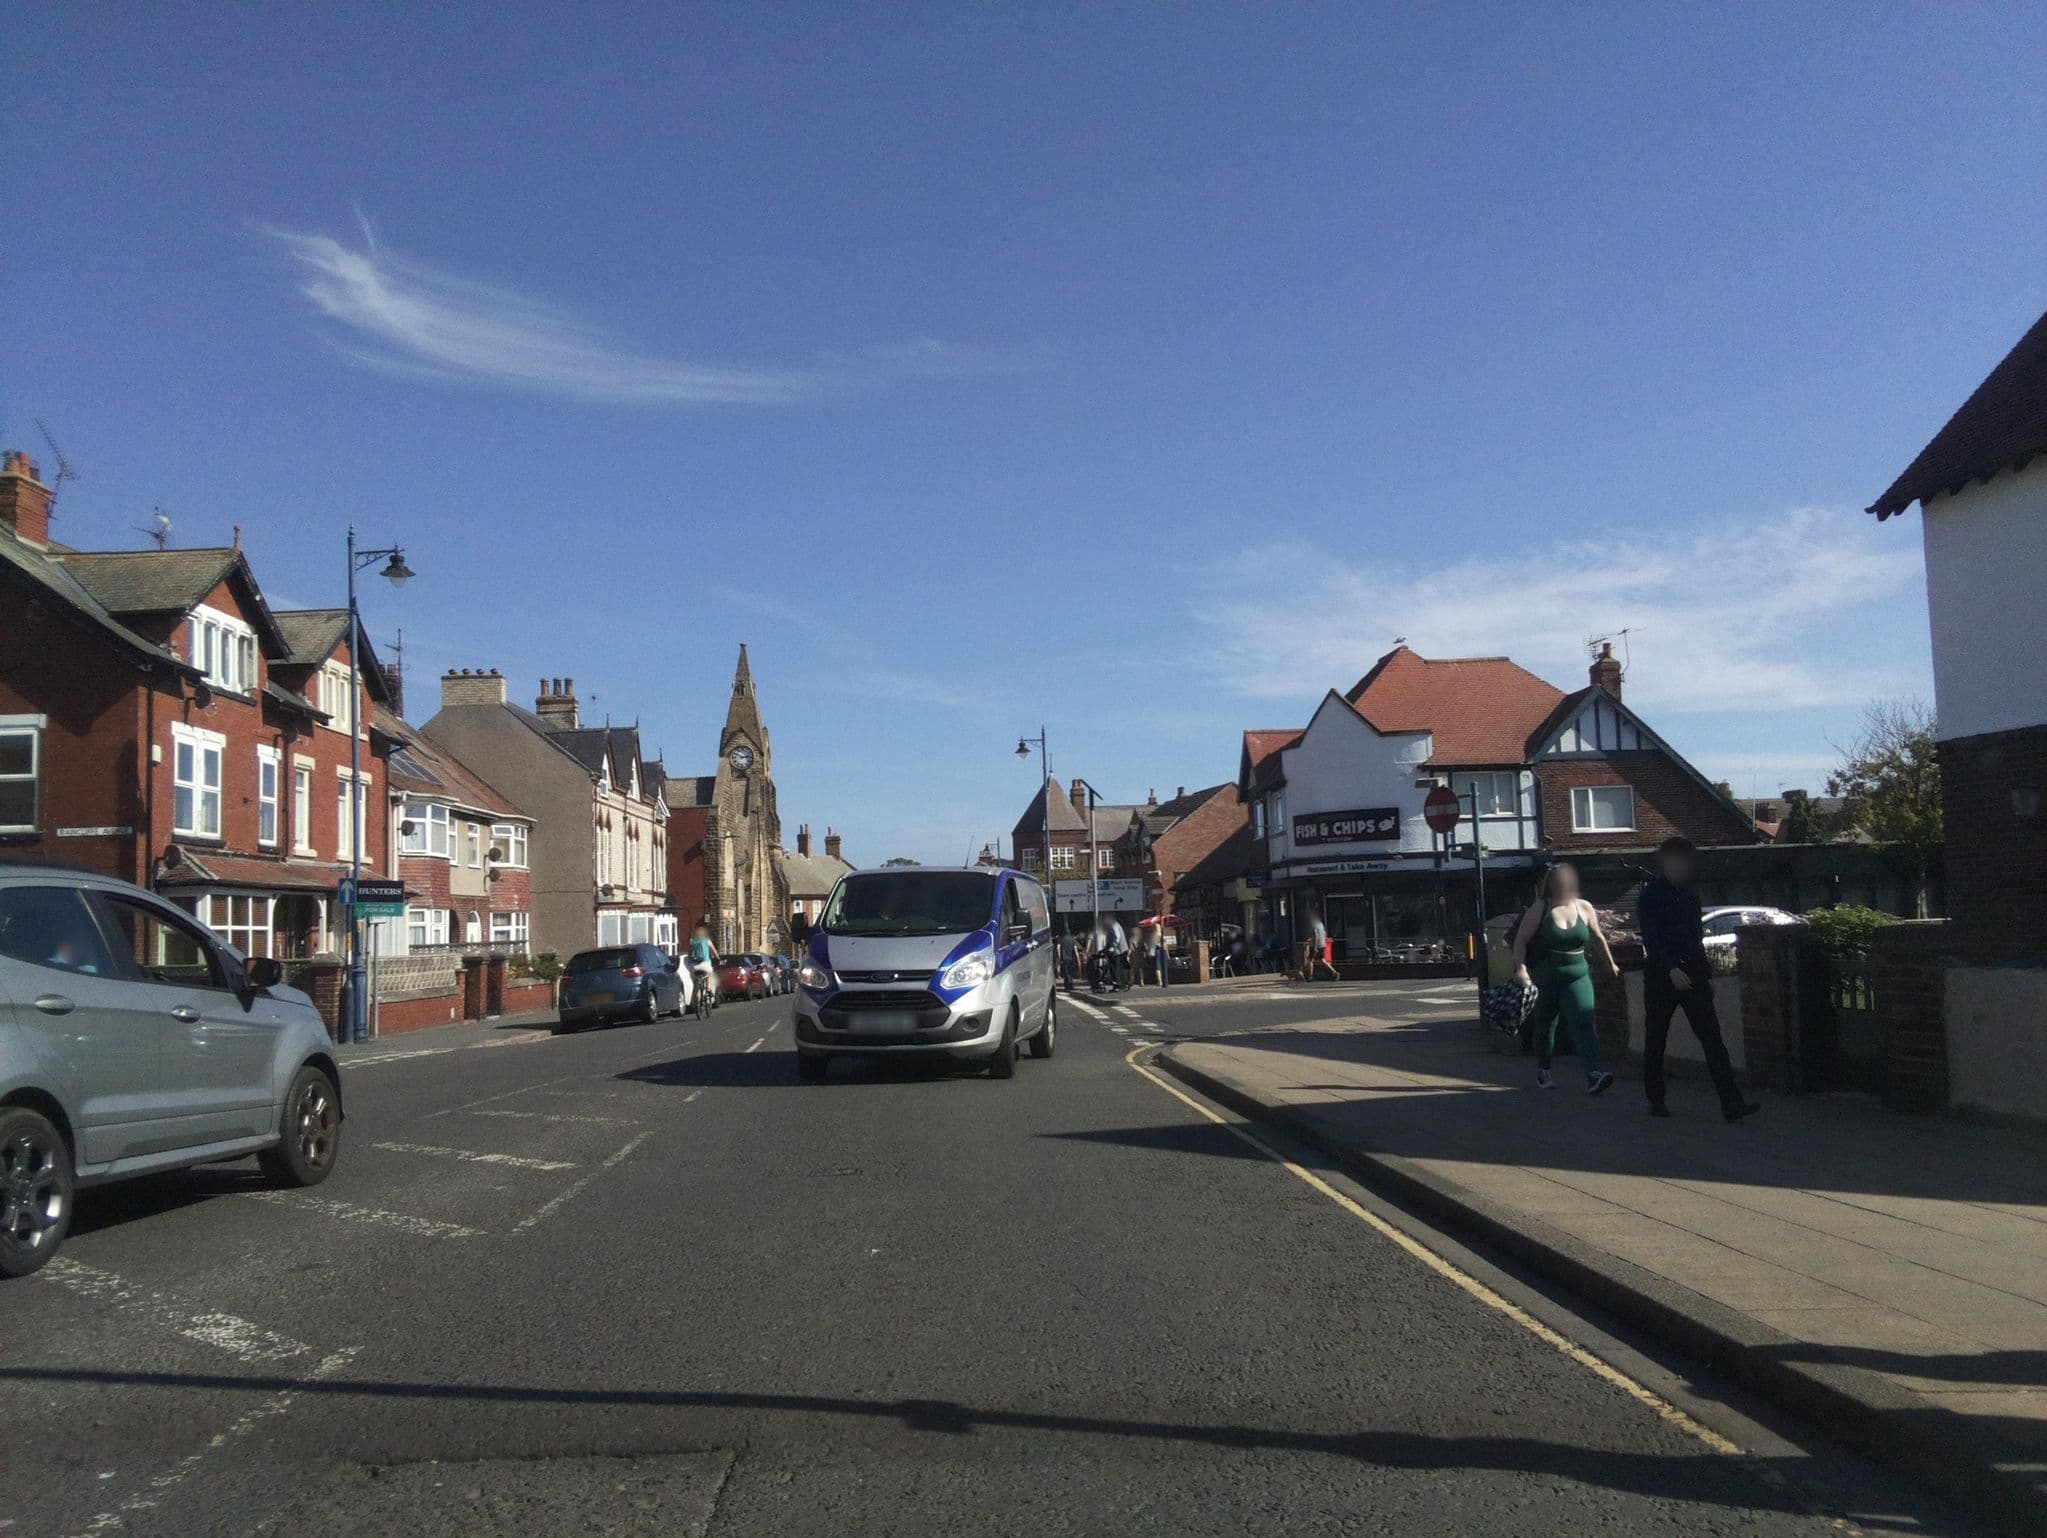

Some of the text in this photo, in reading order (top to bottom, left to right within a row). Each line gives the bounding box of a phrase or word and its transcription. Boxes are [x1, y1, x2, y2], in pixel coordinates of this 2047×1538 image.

[1295, 819, 1376, 839] FISH & CHIPS
[1347, 863, 1365, 871] Take
[1366, 862, 1388, 871] Away
[358, 887, 402, 895] HUNTERS
